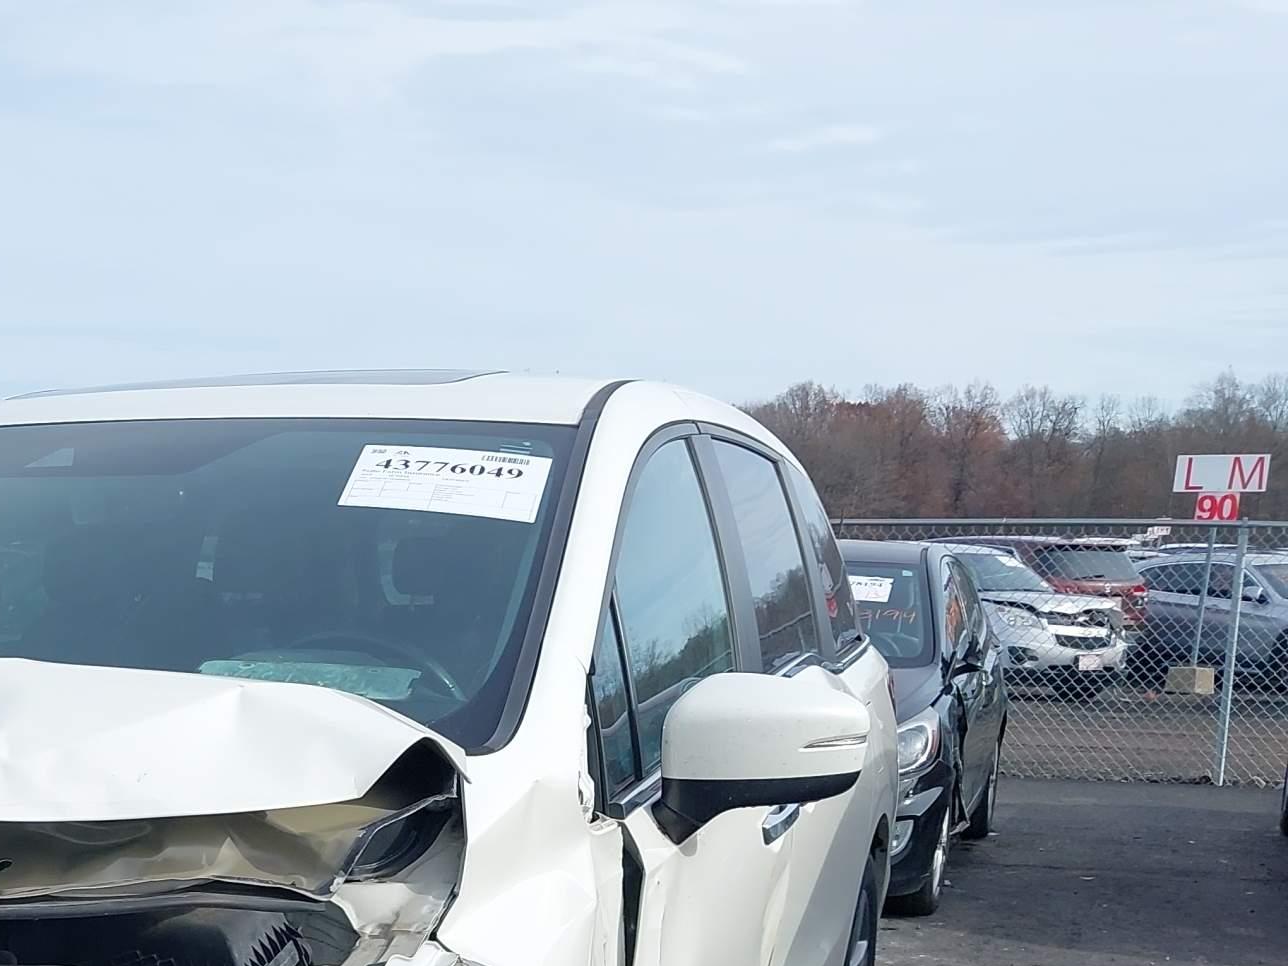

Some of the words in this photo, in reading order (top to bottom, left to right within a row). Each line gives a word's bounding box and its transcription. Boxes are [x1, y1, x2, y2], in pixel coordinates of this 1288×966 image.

[375, 458, 524, 479] 43776049
[1184, 457, 1204, 490] L
[1227, 456, 1266, 490] M
[1196, 493, 1238, 521] 90
